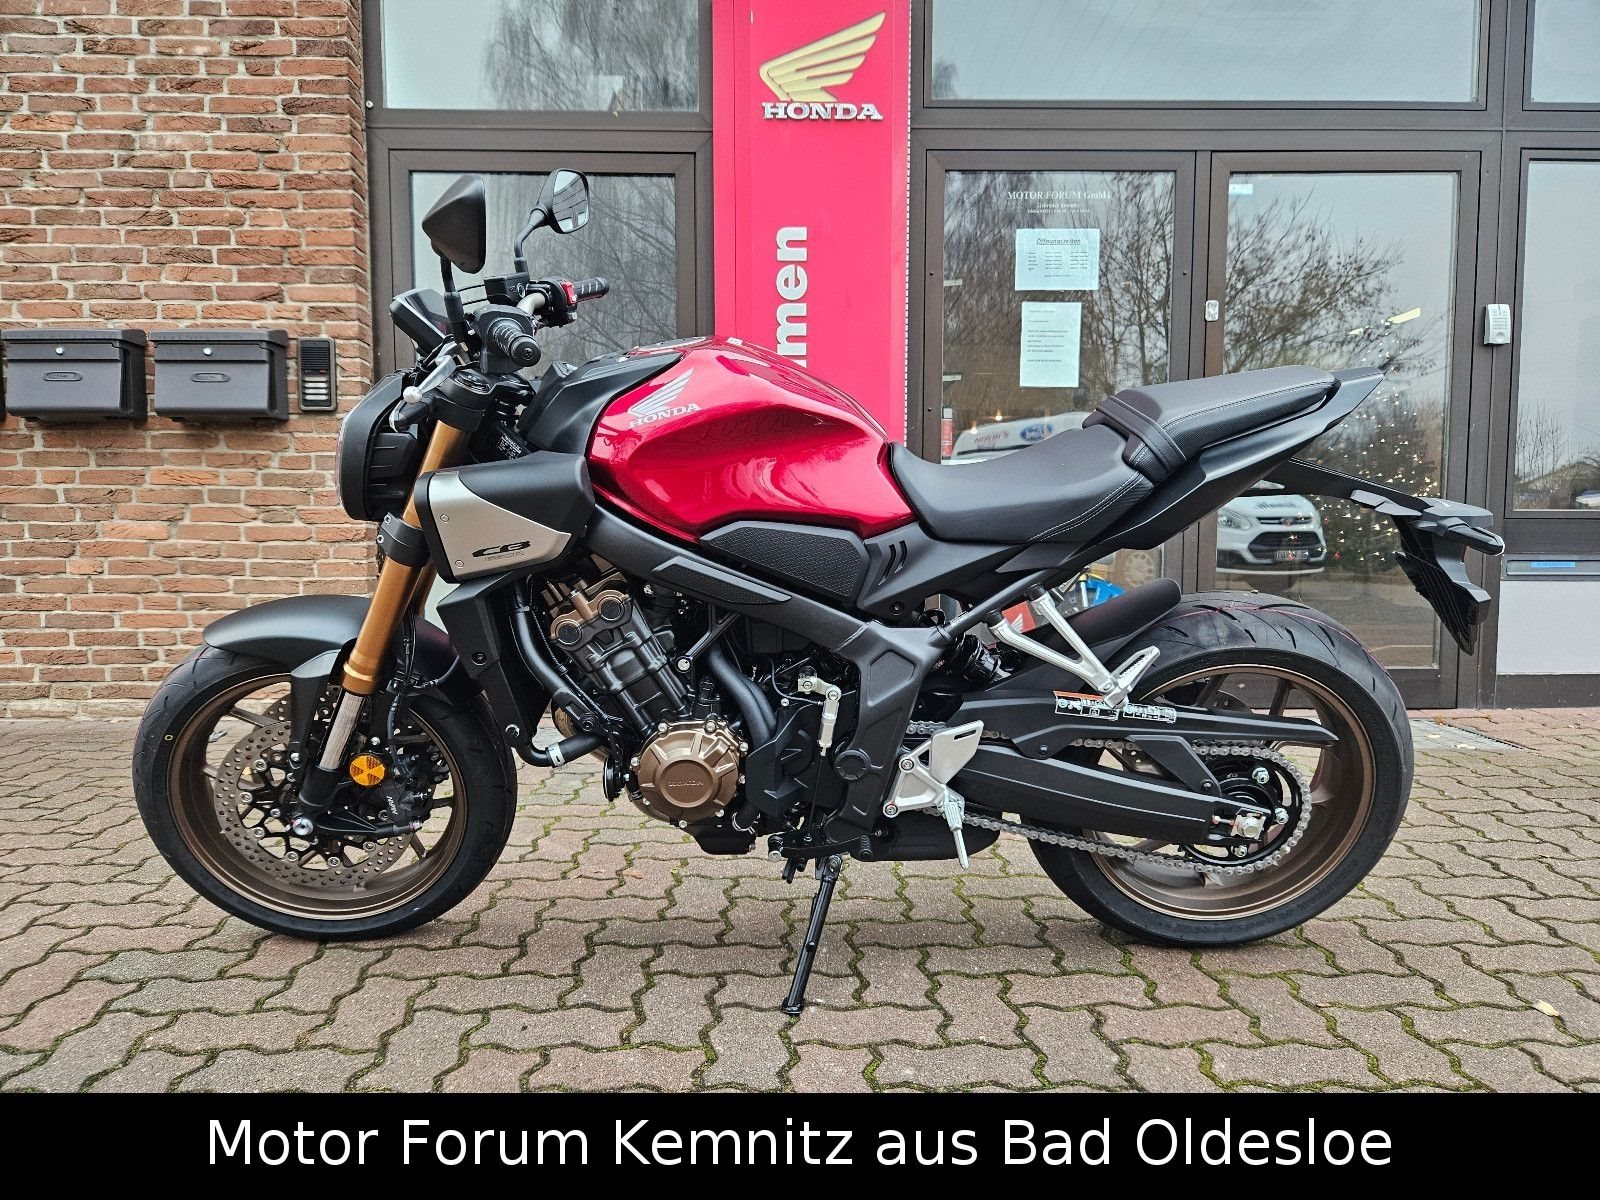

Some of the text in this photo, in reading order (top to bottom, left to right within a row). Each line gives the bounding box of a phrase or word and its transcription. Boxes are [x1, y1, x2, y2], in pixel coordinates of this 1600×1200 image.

[762, 101, 884, 121] HONDA
[1007, 191, 1111, 200] MOTOR FORUM GmbH
[776, 225, 809, 369] men
[628, 403, 703, 429] HONDA
[472, 541, 531, 557] CB
